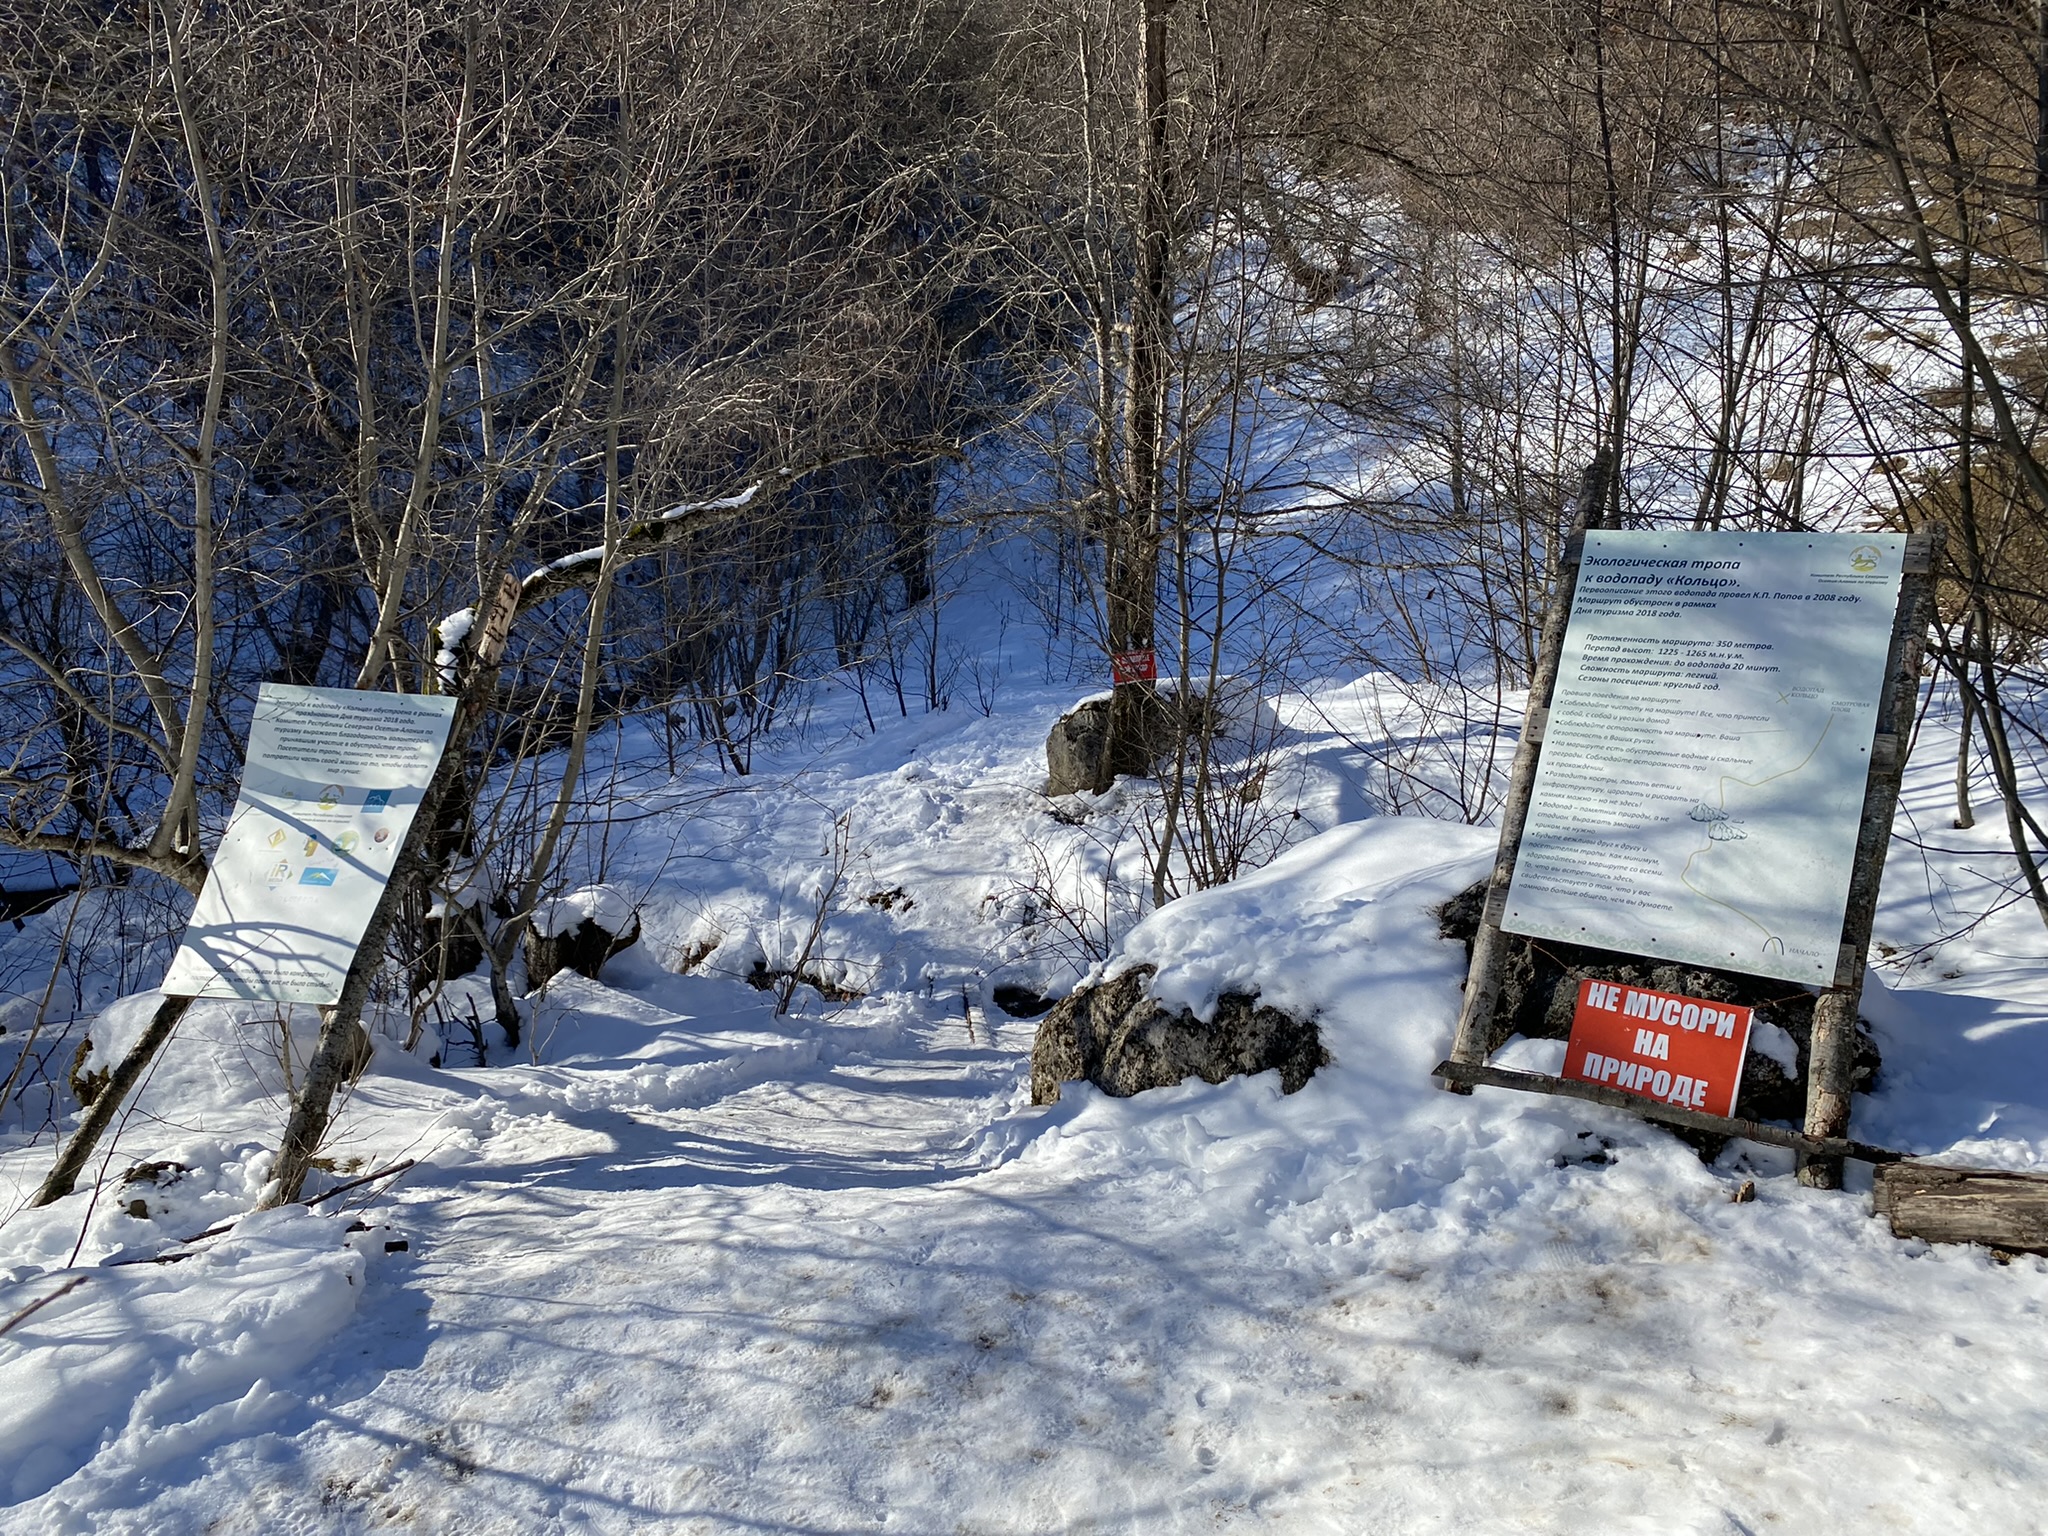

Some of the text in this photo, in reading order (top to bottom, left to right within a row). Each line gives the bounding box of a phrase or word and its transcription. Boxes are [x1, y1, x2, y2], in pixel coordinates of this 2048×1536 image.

[1584, 556, 1741, 570] Экологическая тропа
[1584, 573, 1740, 588] к водопаду «Кольцо».
[1577, 596, 1622, 604] Маршрут
[1623, 598, 1673, 606] обустроен
[1579, 586, 1642, 594] Первоописание
[1837, 594, 1861, 602] году.
[1574, 606, 1592, 614] Дня
[1583, 643, 1620, 652] Перепад
[1658, 647, 1678, 655] 1225
[1585, 633, 1660, 643] Протяженность
[1661, 639, 1713, 647] маршрута:
[1734, 642, 1774, 650] метров.
[1579, 664, 1630, 673] Сложность
[1631, 668, 1682, 677] маршрута:
[1581, 653, 1609, 662] Время
[1610, 657, 1671, 665] прохождения:
[1687, 660, 1730, 669] водопада
[1733, 662, 1744, 670] 20
[1745, 665, 1780, 673] минут.
[1577, 674, 1609, 682] Сезоны
[1610, 678, 1661, 686] посещения:
[1663, 681, 1701, 689] круглый
[1586, 982, 1737, 1039] НЕ МУСОРИ
[1633, 1028, 1670, 1061] НА
[1582, 1052, 1709, 1107] ПРИРОДЕ
